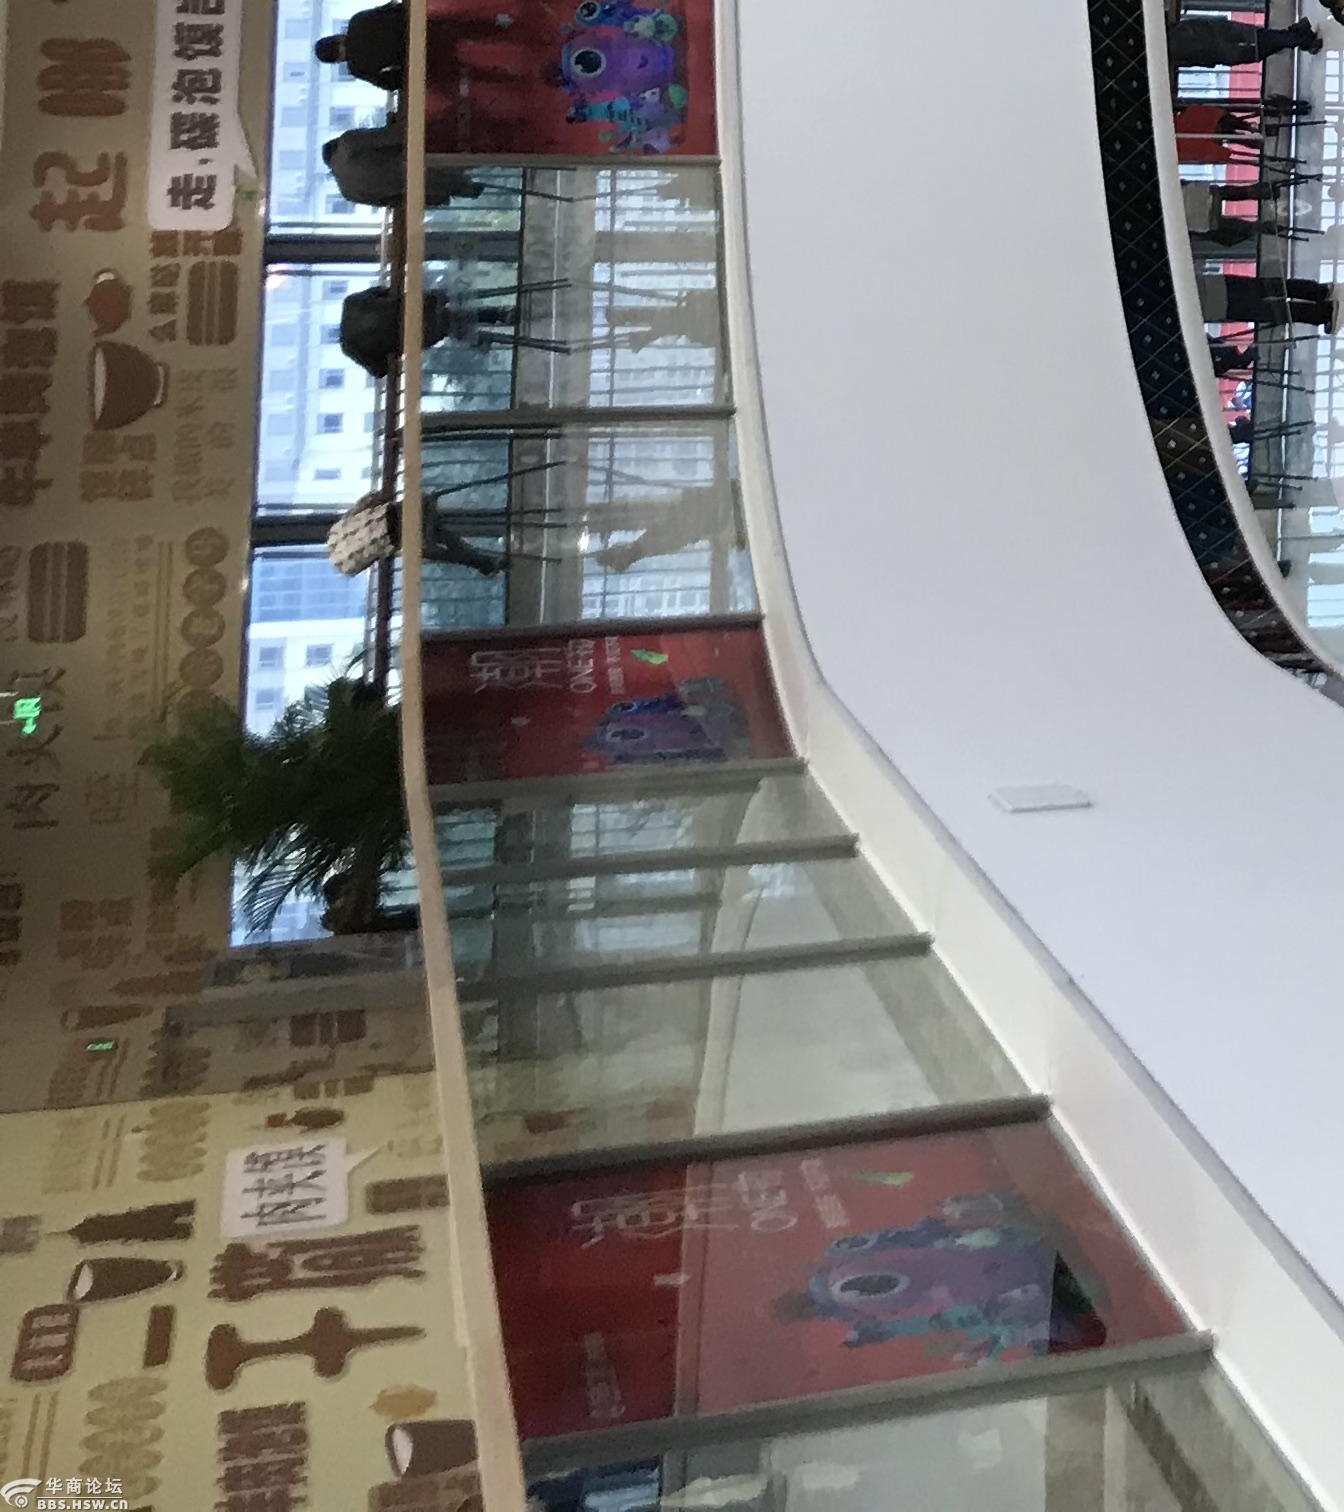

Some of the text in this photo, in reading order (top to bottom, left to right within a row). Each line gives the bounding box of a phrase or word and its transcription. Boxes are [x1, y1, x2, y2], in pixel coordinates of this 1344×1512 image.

[470, 646, 562, 692] 潮
[240, 1143, 330, 1226] 肉夹馍
